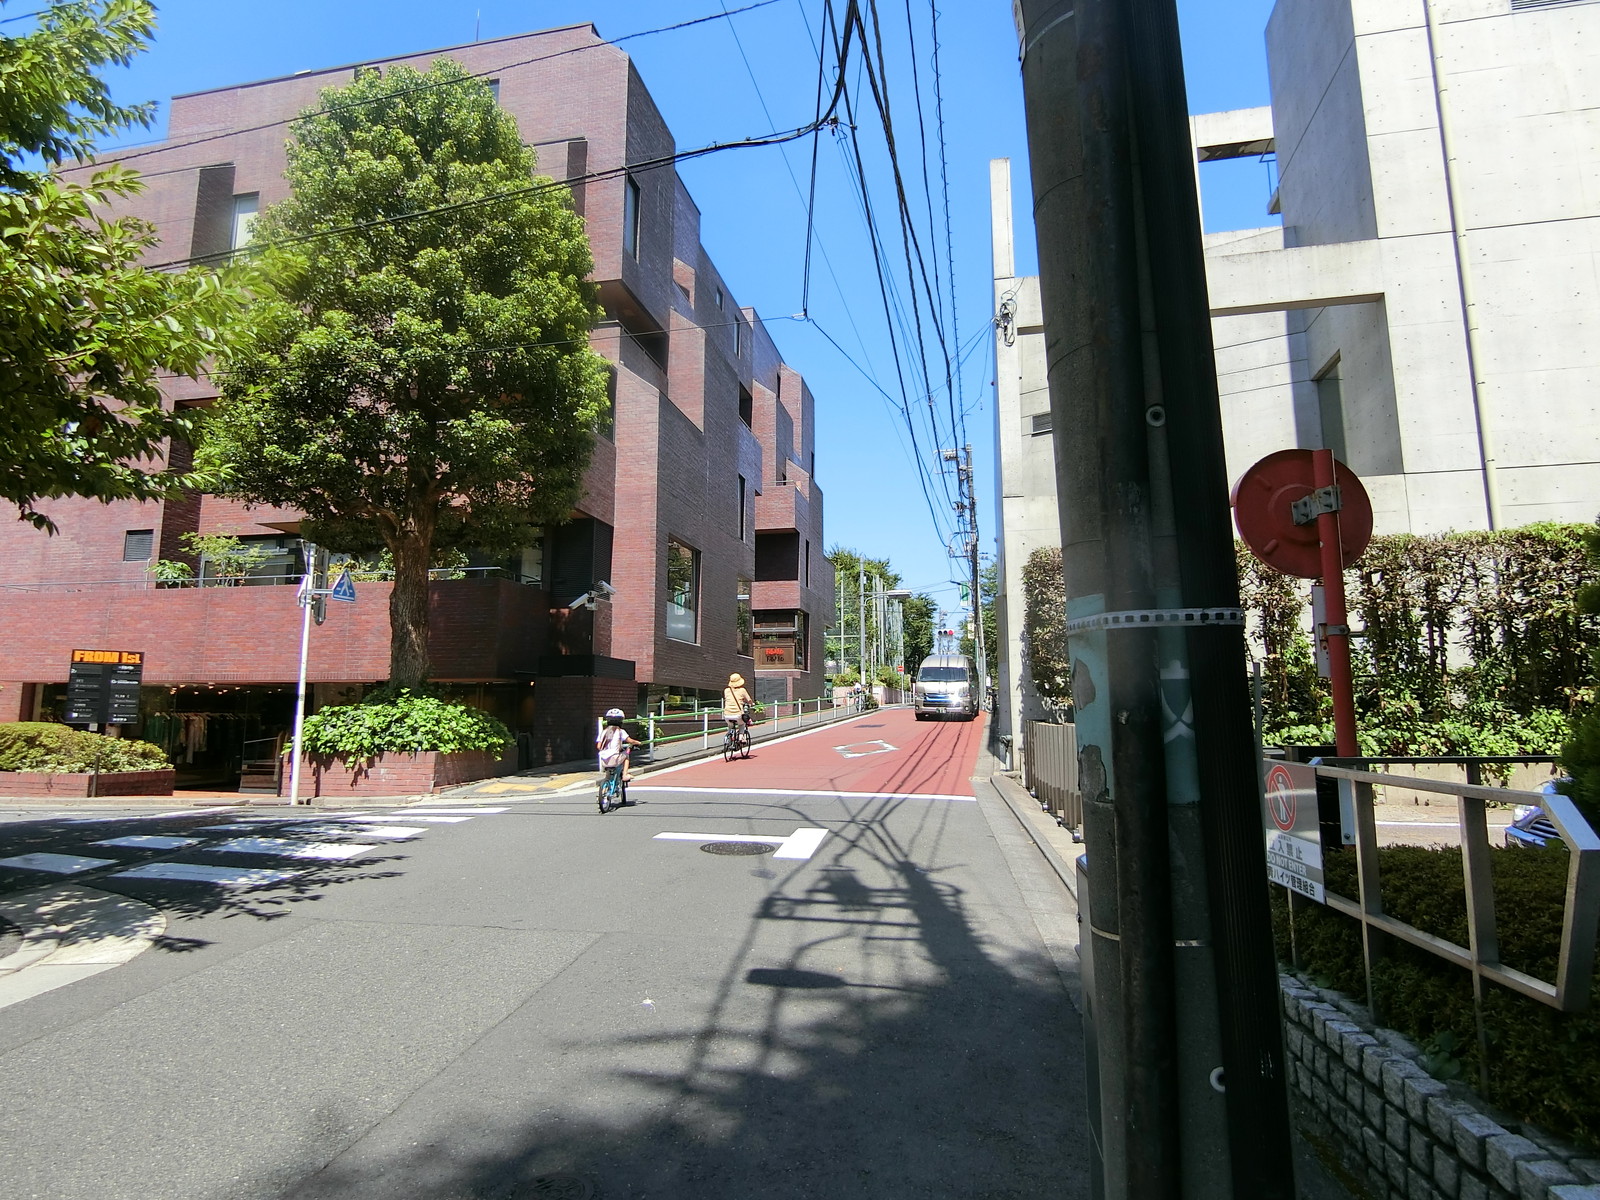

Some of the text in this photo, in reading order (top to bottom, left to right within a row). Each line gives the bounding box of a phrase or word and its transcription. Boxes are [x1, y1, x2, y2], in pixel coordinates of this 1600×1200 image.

[73, 650, 120, 663] FROM
[1267, 852, 1307, 877] DO NOT ENTER
